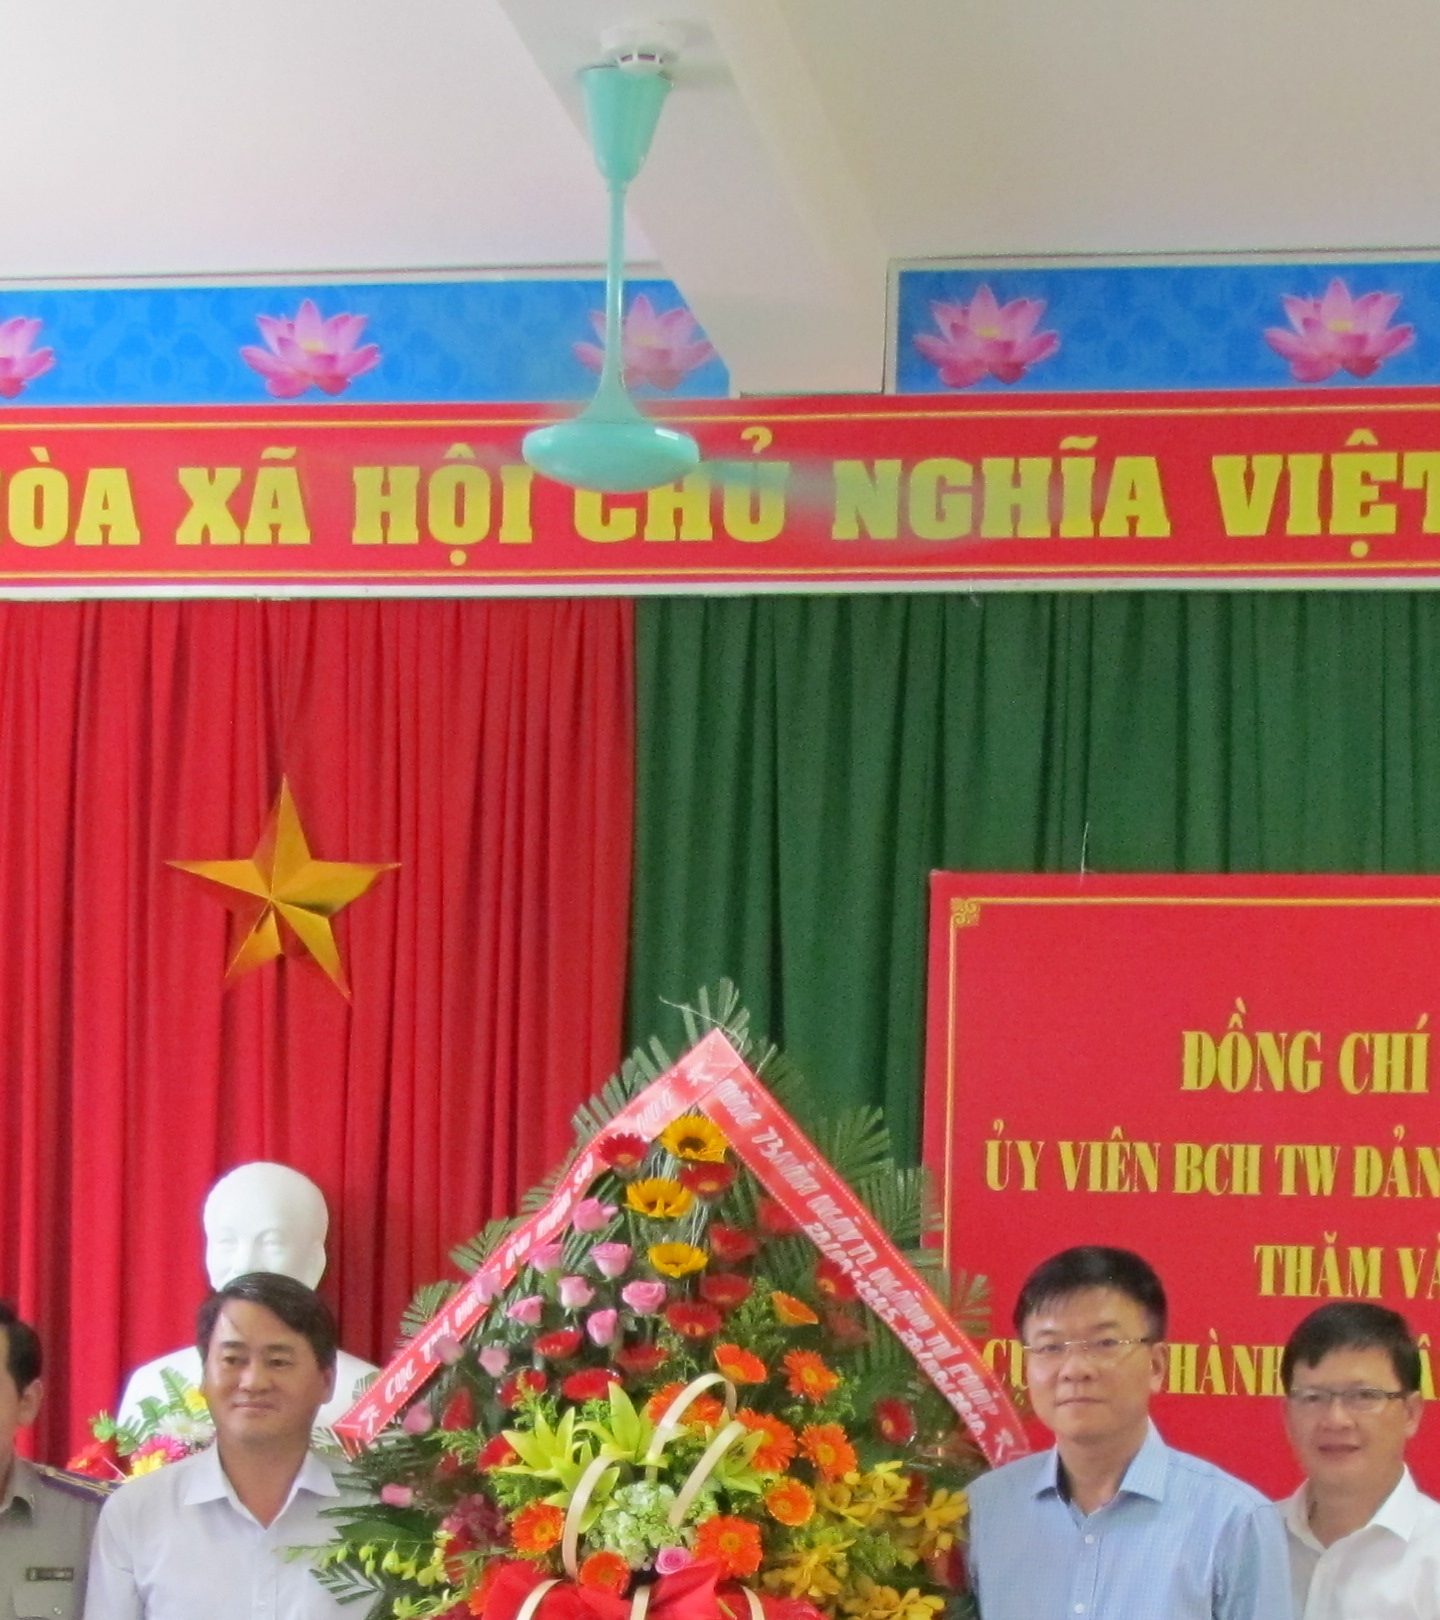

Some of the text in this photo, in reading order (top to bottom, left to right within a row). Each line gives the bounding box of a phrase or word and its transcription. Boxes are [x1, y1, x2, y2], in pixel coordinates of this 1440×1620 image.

[175, 447, 310, 545] XÃ
[352, 444, 536, 565] HỘI
[574, 426, 790, 542] CHỦ
[831, 436, 1170, 541] NGHĨA
[1183, 1000, 1322, 1092] ĐỒNG
[1340, 1016, 1429, 1094] CHÍ
[985, 1119, 1045, 1192] ỦY
[1059, 1128, 1158, 1192] VIÊN
[1175, 1143, 1261, 1195] BCH
[1275, 1145, 1335, 1195] TW
[1255, 1235, 1382, 1298] THĂM
